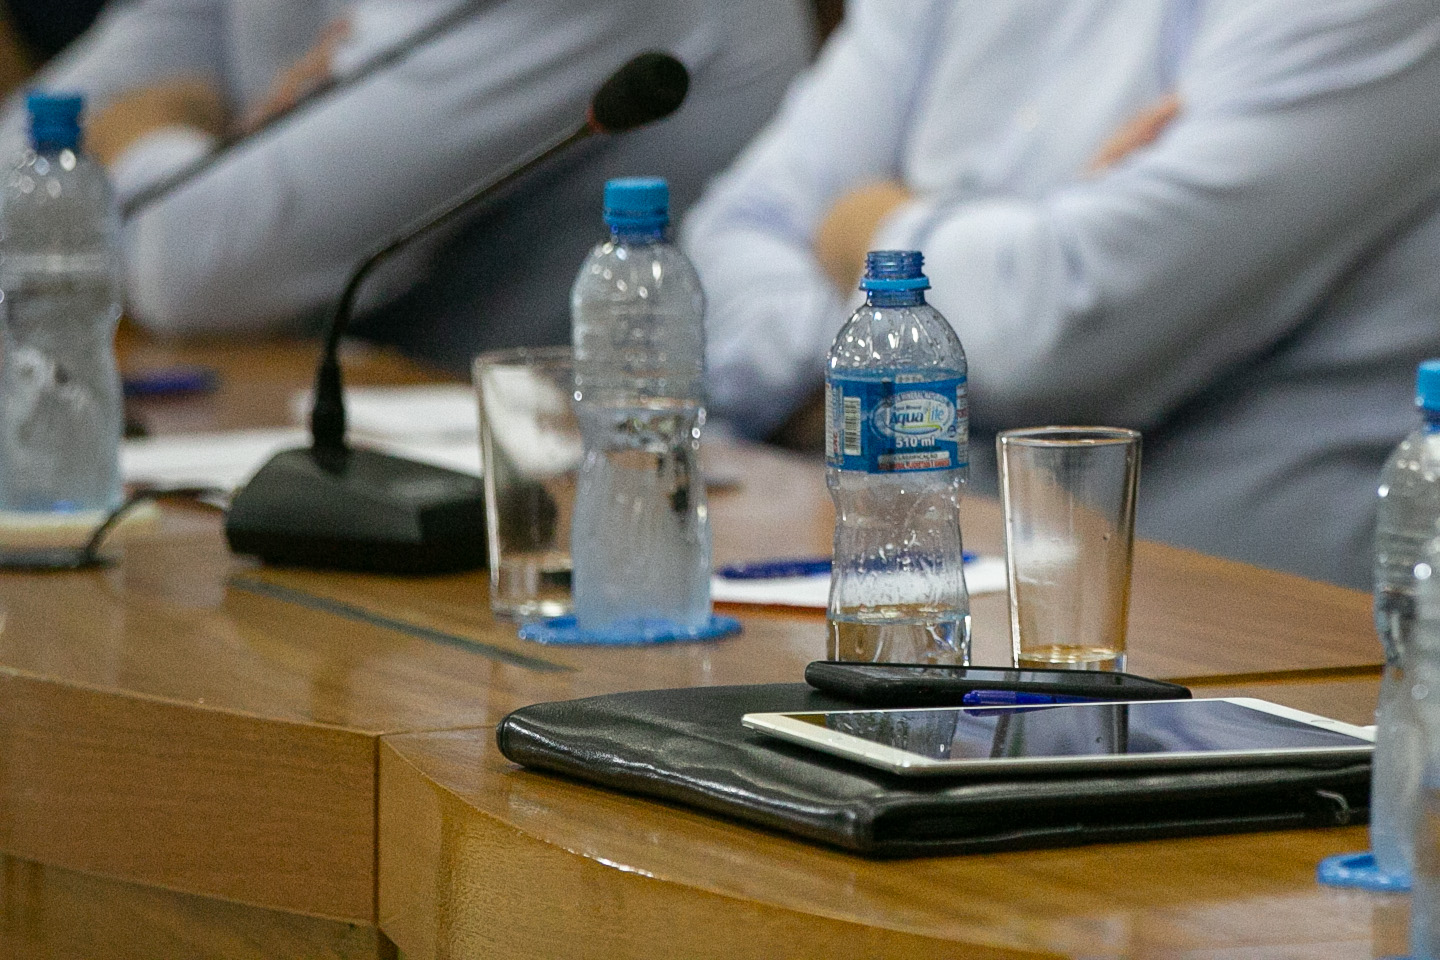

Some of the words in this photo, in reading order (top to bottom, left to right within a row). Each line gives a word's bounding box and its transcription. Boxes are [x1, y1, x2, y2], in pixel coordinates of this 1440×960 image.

[889, 411, 924, 427] Aqua
[895, 437, 918, 448] 510
[921, 436, 935, 446] ml
